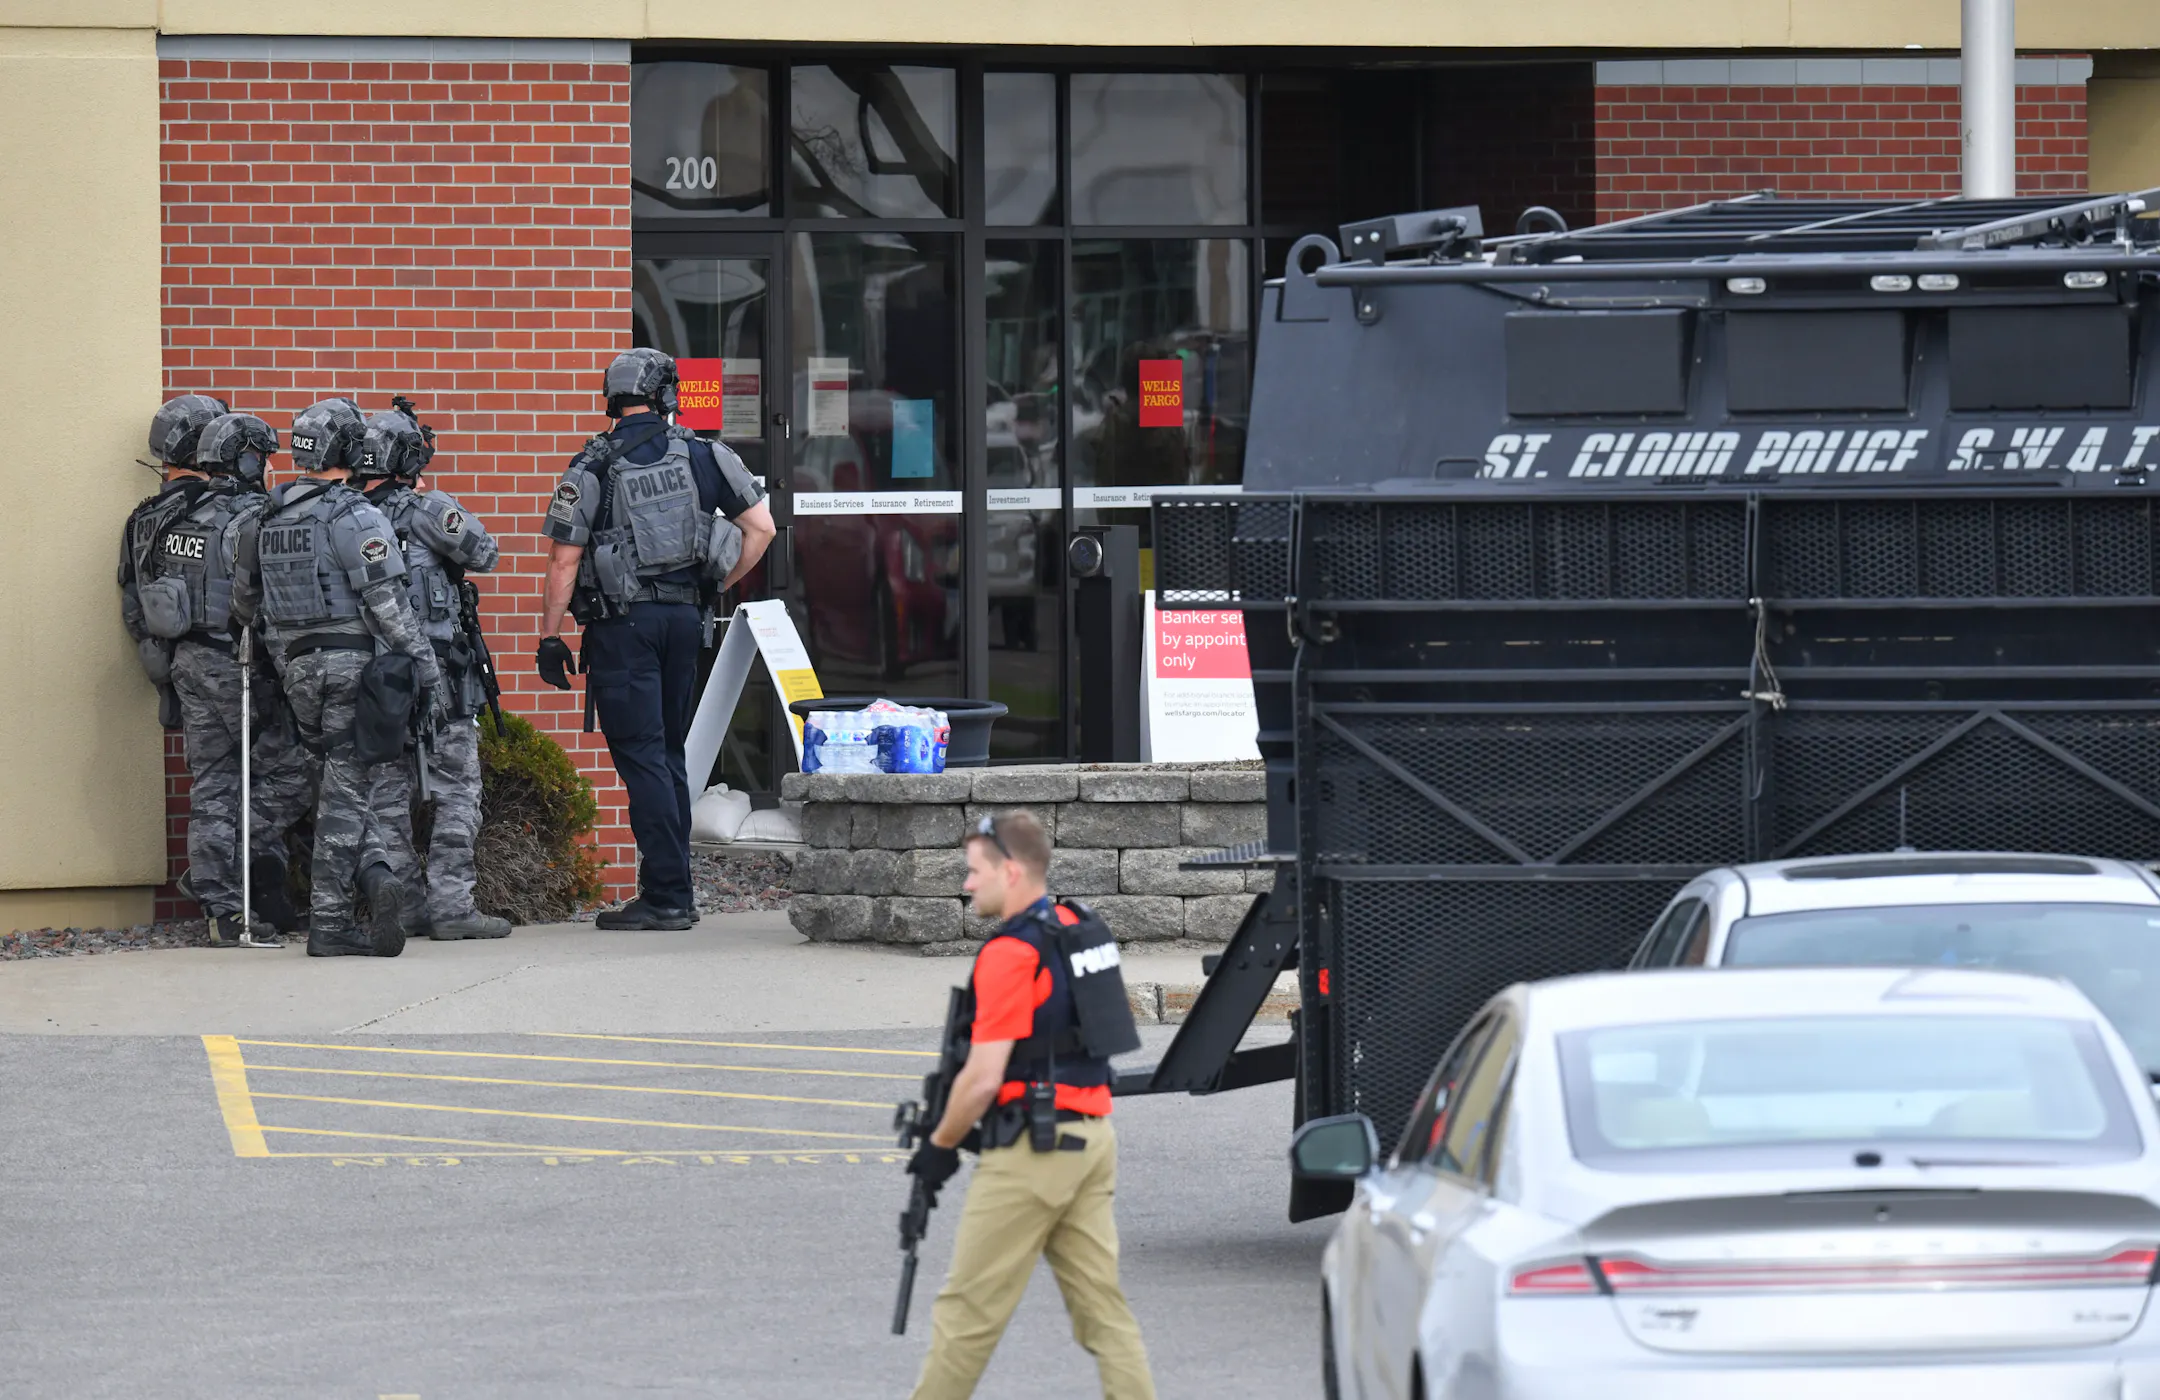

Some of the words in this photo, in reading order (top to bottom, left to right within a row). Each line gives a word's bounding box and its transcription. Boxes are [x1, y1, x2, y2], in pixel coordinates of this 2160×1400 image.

[666, 156, 717, 190] 200
[679, 380, 720, 393] WELLS
[1142, 380, 1181, 392] WELLS
[679, 395, 720, 408] FARGO
[1143, 395, 1181, 407] FARGO
[292, 435, 314, 450] POLICE
[1474, 433, 1552, 479] ST.
[1744, 430, 1929, 474] POLICE
[627, 466, 689, 501] POLICE
[800, 499, 832, 509] Business
[833, 498, 865, 508] Services
[871, 498, 907, 508] Insurance
[914, 497, 954, 507] Retirement
[988, 494, 1031, 505] Investments
[1093, 492, 1127, 502] Insurance
[165, 534, 205, 559] POLICE
[263, 528, 311, 555] POLICE
[1162, 610, 1216, 625] Banker
[1162, 632, 1181, 649] by
[1162, 653, 1196, 670] only
[332, 1156, 462, 1167] NO
